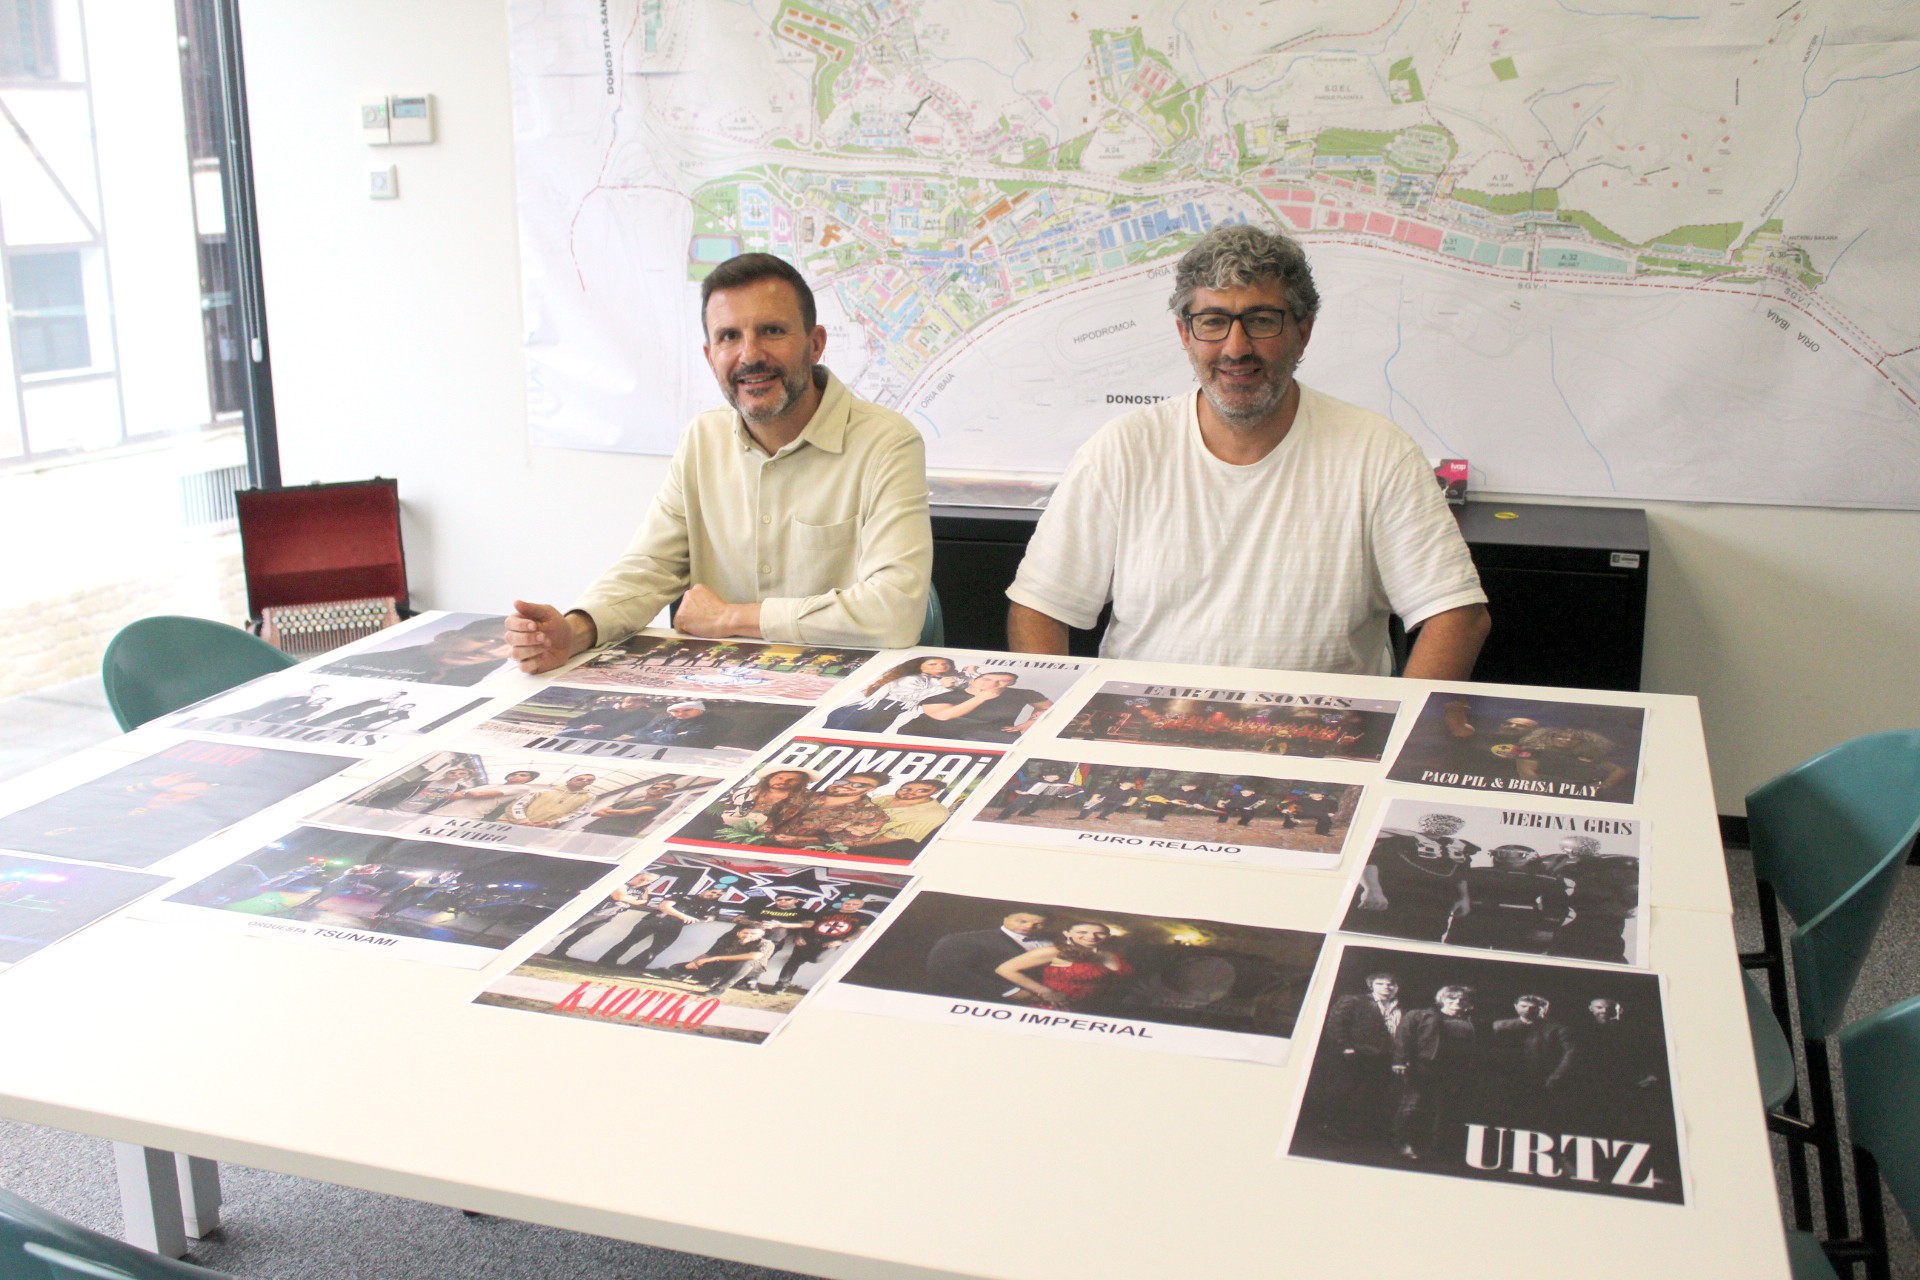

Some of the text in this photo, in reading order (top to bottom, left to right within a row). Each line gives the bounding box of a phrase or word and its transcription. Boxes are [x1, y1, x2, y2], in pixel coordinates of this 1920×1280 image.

[1073, 320, 1137, 344] HIPODROMOA
[1797, 331, 1820, 352] ORIA
[1144, 686, 1353, 708] EARTH SONGS
[523, 736, 669, 761] DUPLA
[1421, 770, 1601, 798] PACO PIL & BRISA PLAY
[1500, 811, 1633, 836] MERINA GRIS
[1078, 833, 1242, 854] PURO RELAJO
[247, 921, 398, 947] ORQUESTA TSUNAMI
[553, 980, 721, 1031] KAOTIKO
[950, 1004, 1154, 1039] DUO IMPERIAL
[1465, 1123, 1655, 1189] URTZ
